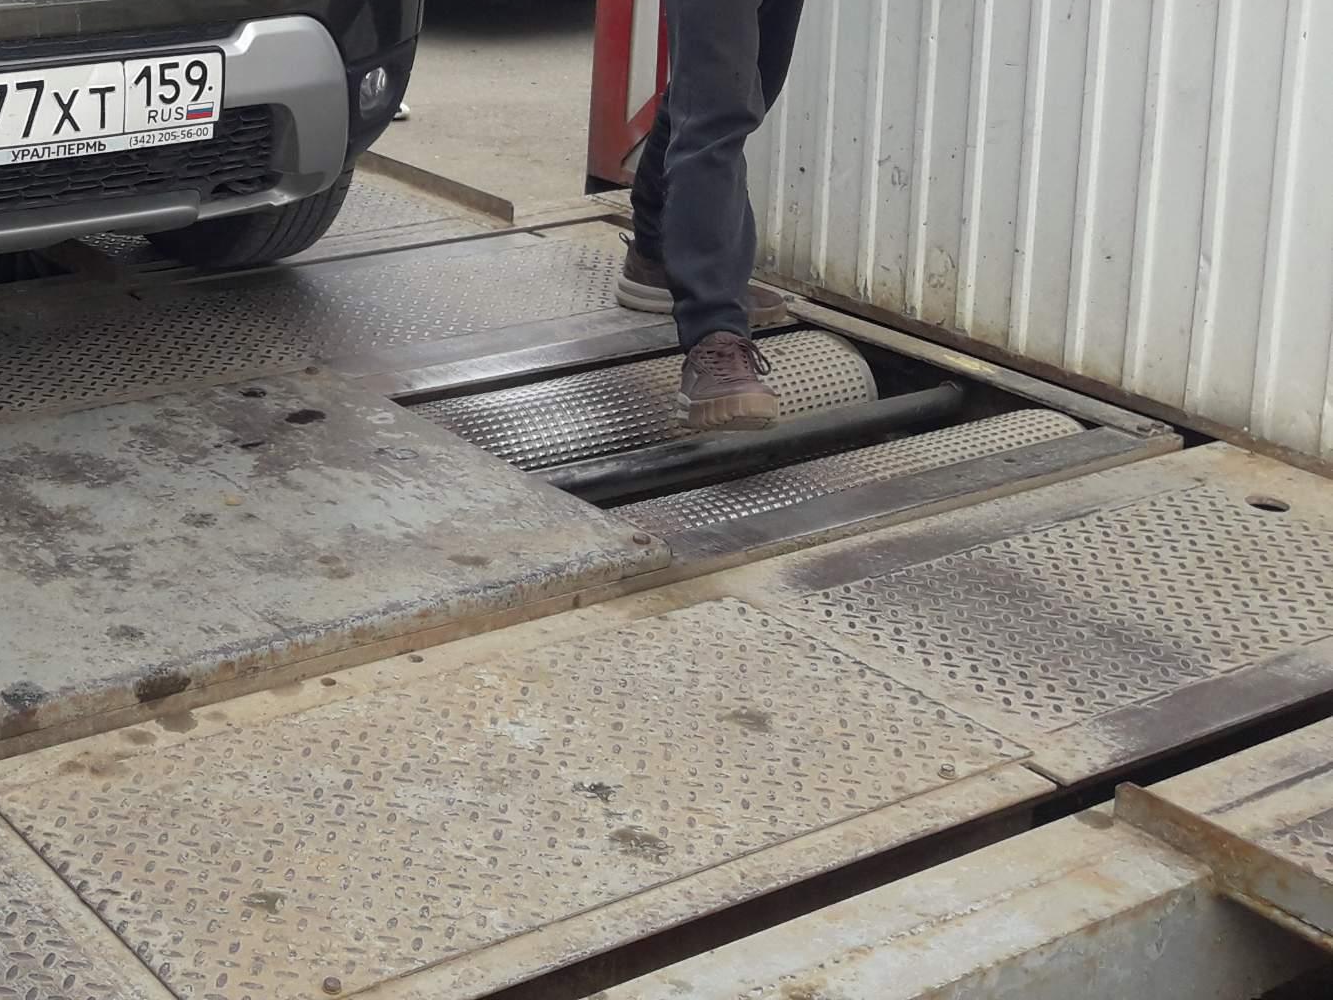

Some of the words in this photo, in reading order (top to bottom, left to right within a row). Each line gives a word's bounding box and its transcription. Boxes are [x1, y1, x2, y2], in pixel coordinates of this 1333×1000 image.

[134, 60, 207, 107] 159
[147, 106, 184, 124] RUS
[129, 133, 155, 148] (342)
[158, 127, 209, 143] 205-56-00
[11, 140, 106, 162] УРАЛ-ПЕРМЬ
